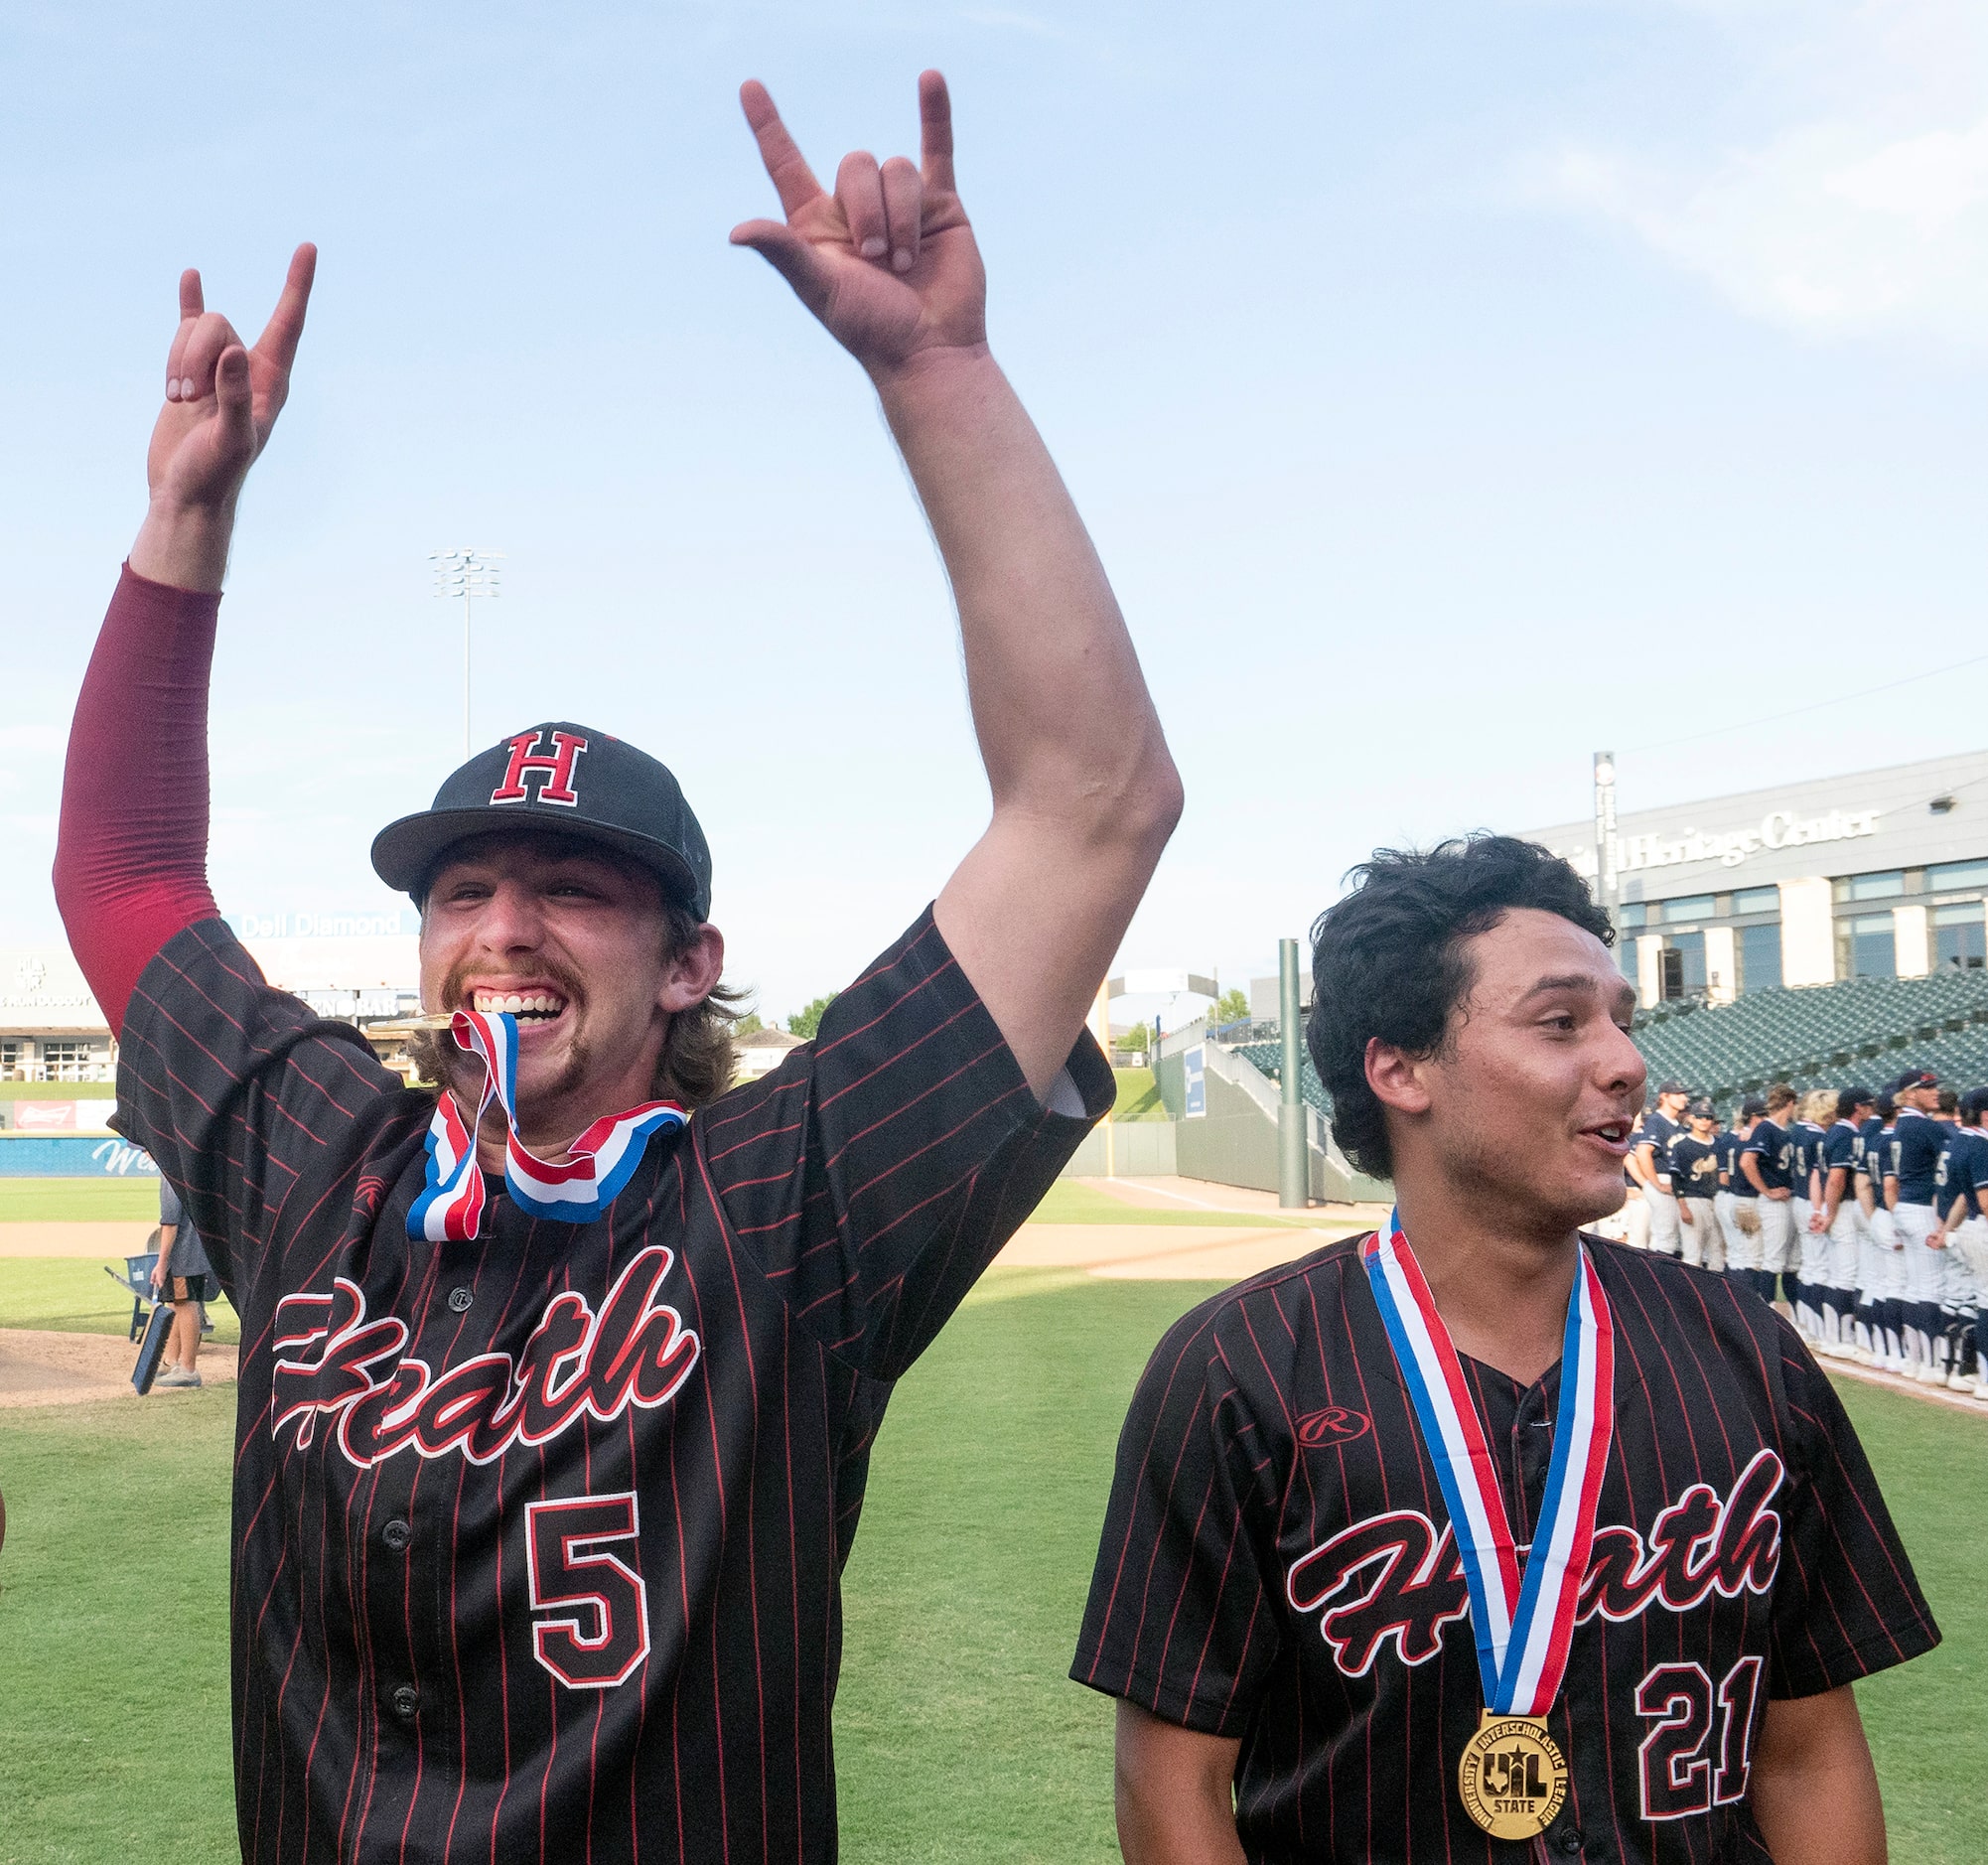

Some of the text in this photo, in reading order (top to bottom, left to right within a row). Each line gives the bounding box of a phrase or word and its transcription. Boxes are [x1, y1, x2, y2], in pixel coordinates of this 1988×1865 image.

[490, 731, 588, 807] H
[1629, 826, 1761, 867] Heritage
[1761, 809, 1880, 850] Center
[241, 911, 401, 937] Dell Diamond
[355, 999, 398, 1017] BAR
[272, 1245, 700, 1469] Heath
[524, 1491, 651, 1689] 5
[1288, 1448, 1786, 1678] Hath
[1464, 1722, 1567, 1828] UNIVERSITY INTERSCHOLASTIC LEAGUE
[1484, 1745, 1548, 1798] UIL
[1634, 1655, 1764, 1820] 21
[1494, 1799, 1535, 1813] STATE
